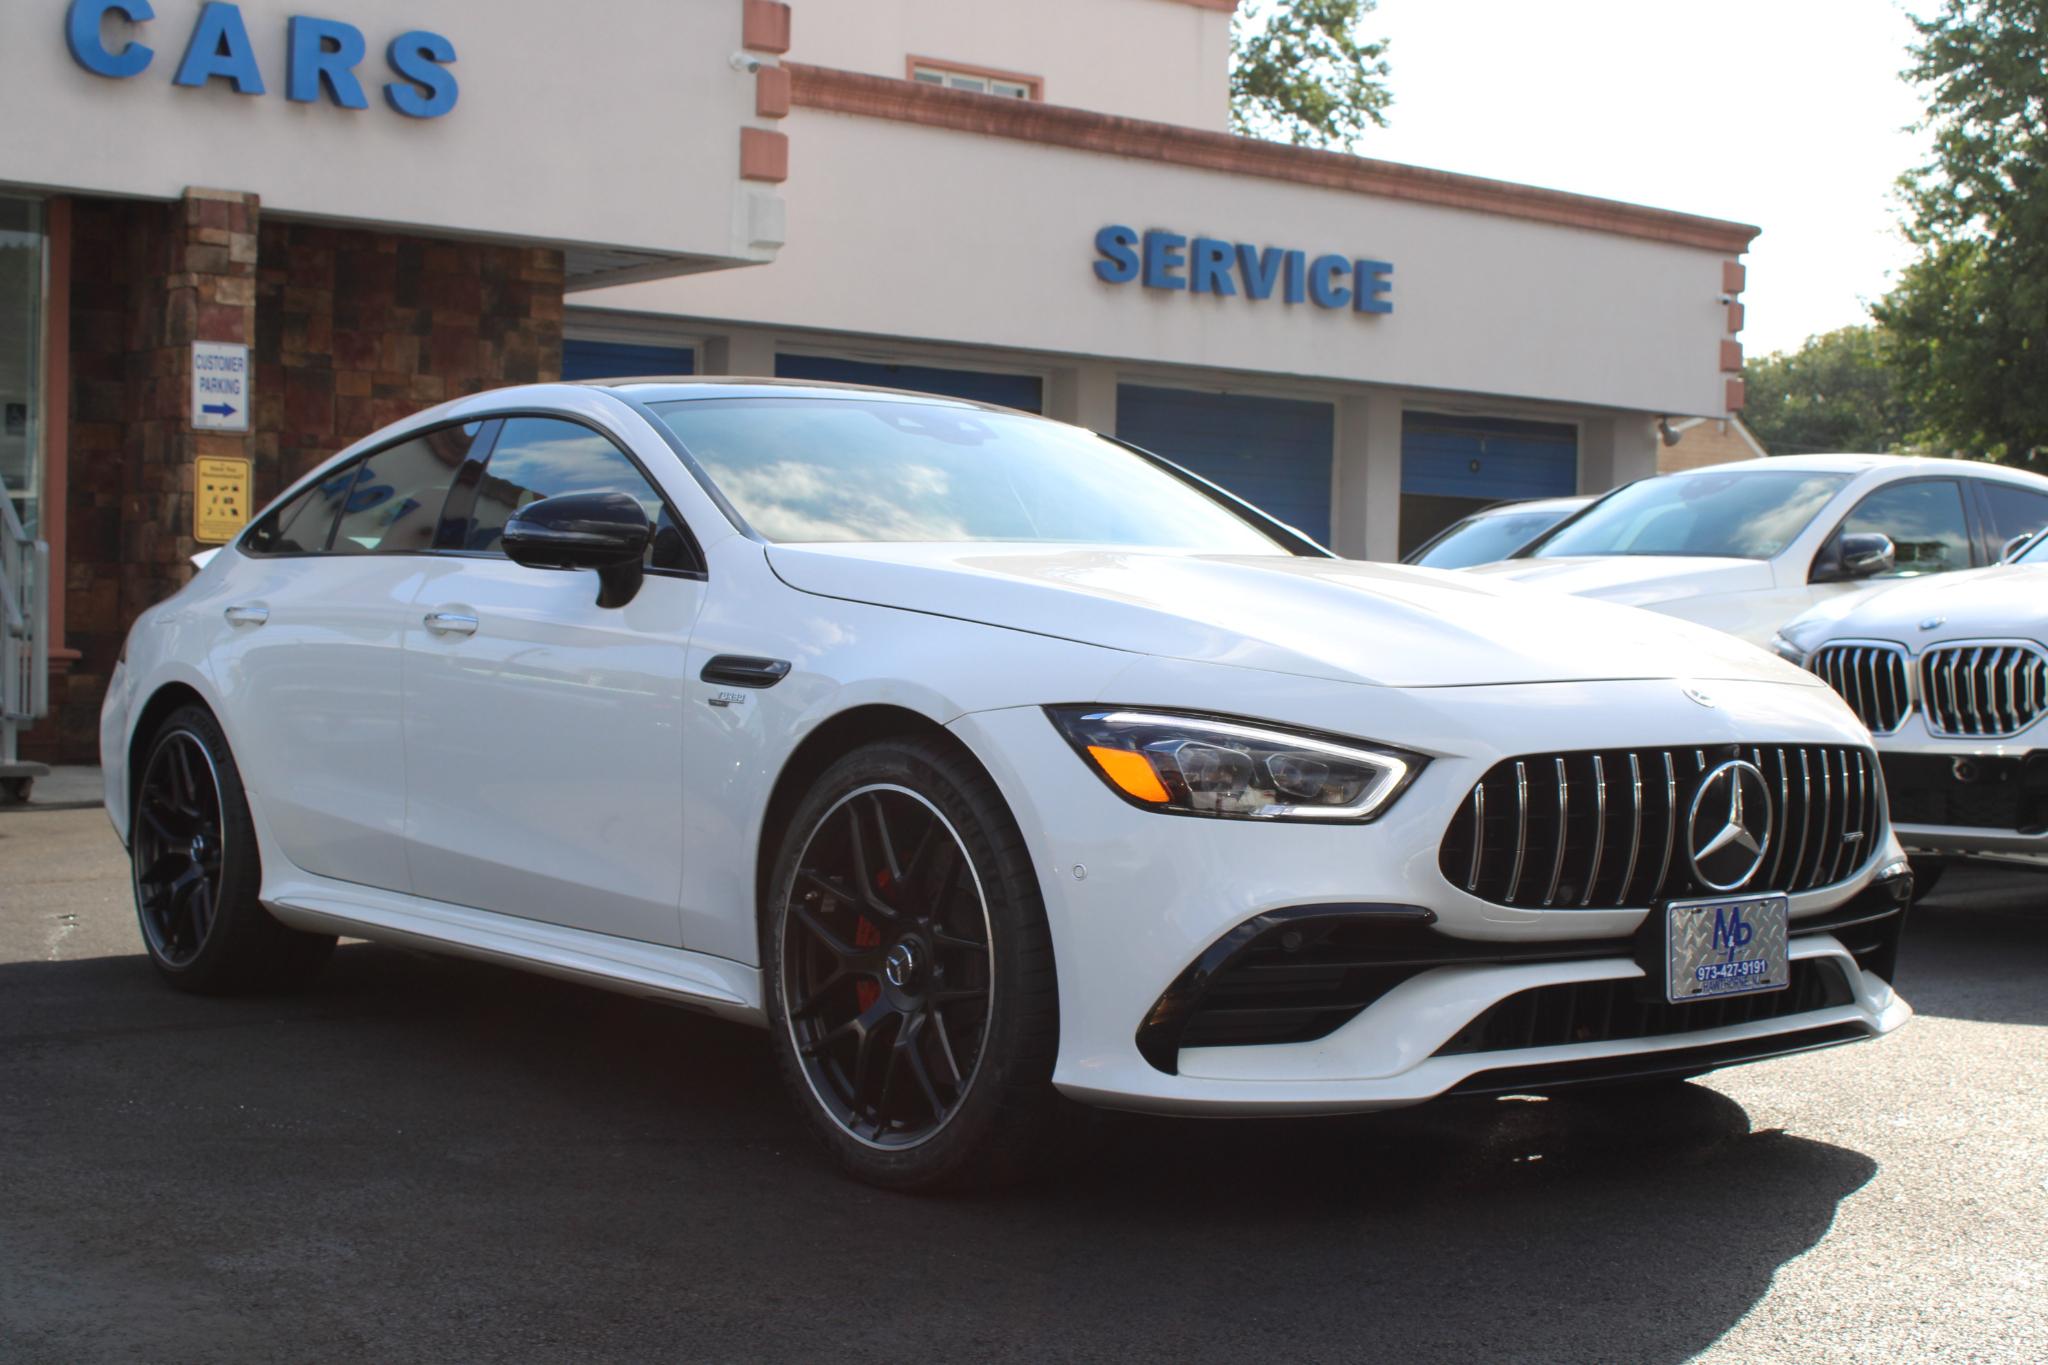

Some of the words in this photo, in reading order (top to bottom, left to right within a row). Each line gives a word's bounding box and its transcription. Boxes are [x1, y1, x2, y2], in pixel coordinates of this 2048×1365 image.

[65, 0, 460, 119] CARS
[1092, 224, 1394, 315] SERVICE
[196, 354, 244, 372] CUSTOMER
[200, 376, 241, 395] PARKING
[1698, 959, 1766, 981] 973-427-9191
